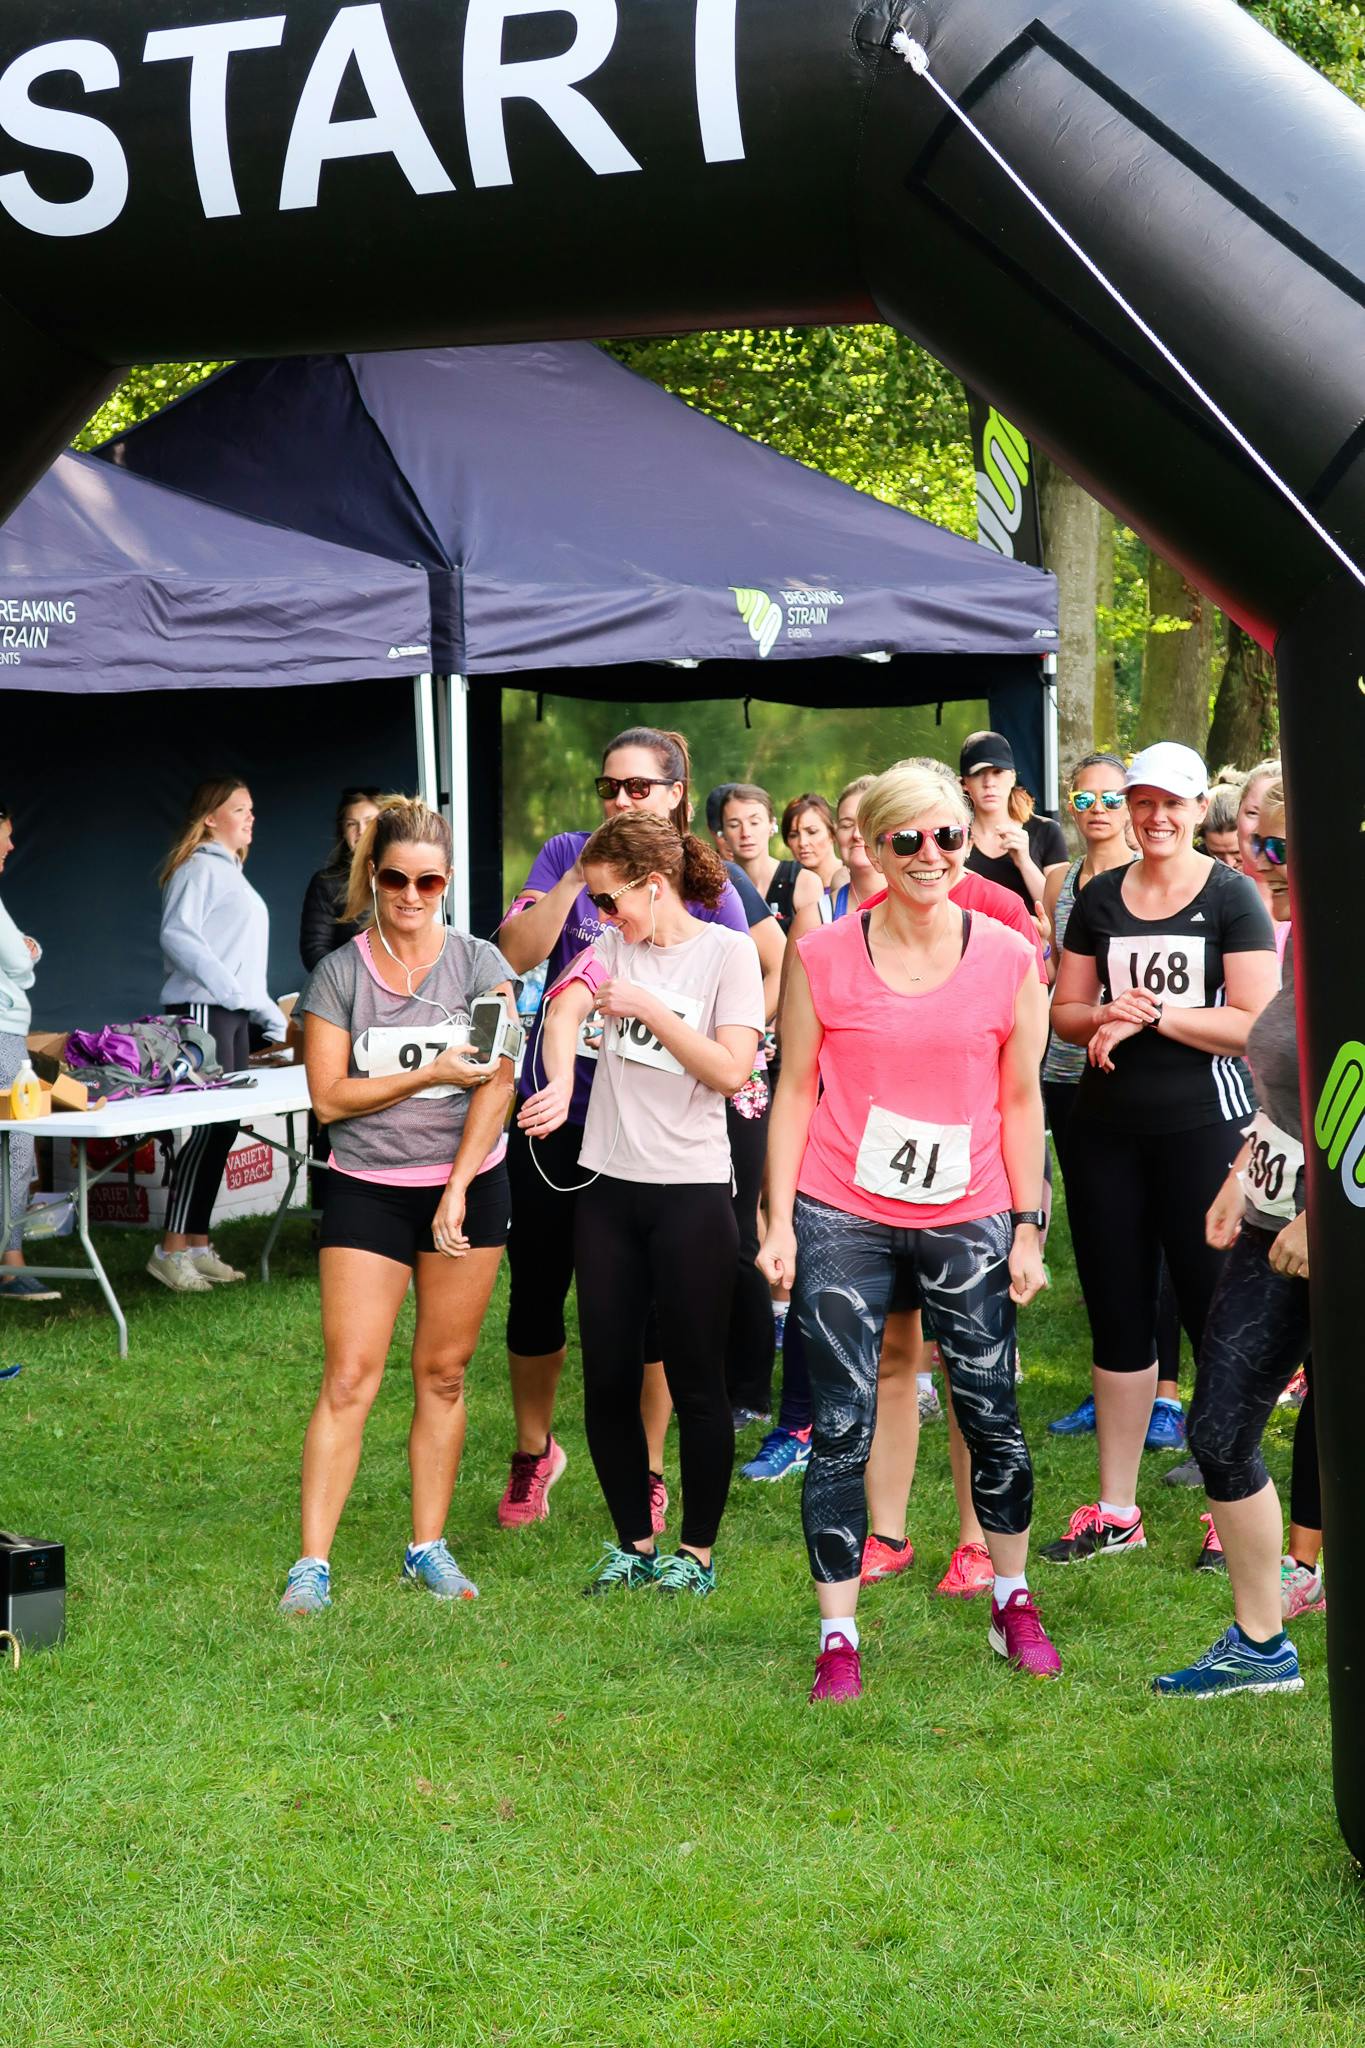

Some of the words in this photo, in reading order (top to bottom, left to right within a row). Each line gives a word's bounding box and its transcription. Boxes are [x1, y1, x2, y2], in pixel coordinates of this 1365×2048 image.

[779, 590, 844, 605] BREAKING
[787, 607, 829, 625] STRAIN
[1129, 951, 1190, 995] 168
[399, 1042, 448, 1072] 97
[226, 1145, 269, 1171] VARIETY
[889, 1139, 940, 1189] 41
[229, 1171, 241, 1189] 30
[243, 1161, 270, 1184] PACK
